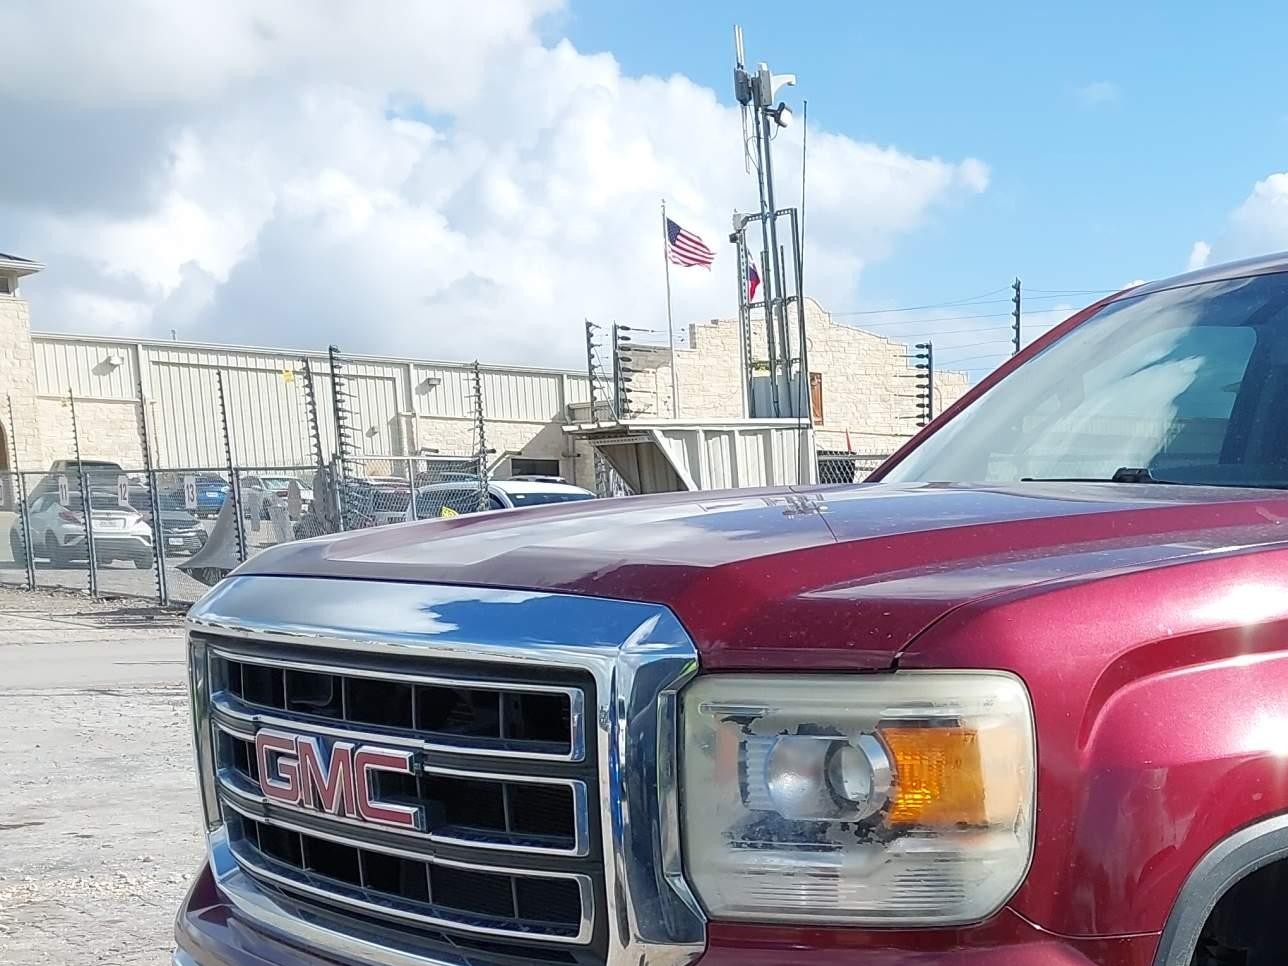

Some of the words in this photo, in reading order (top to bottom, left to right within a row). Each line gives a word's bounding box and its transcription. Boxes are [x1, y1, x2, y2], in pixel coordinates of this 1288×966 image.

[119, 483, 127, 500] 12
[186, 484, 194, 502] 13
[256, 728, 421, 830] GMC
